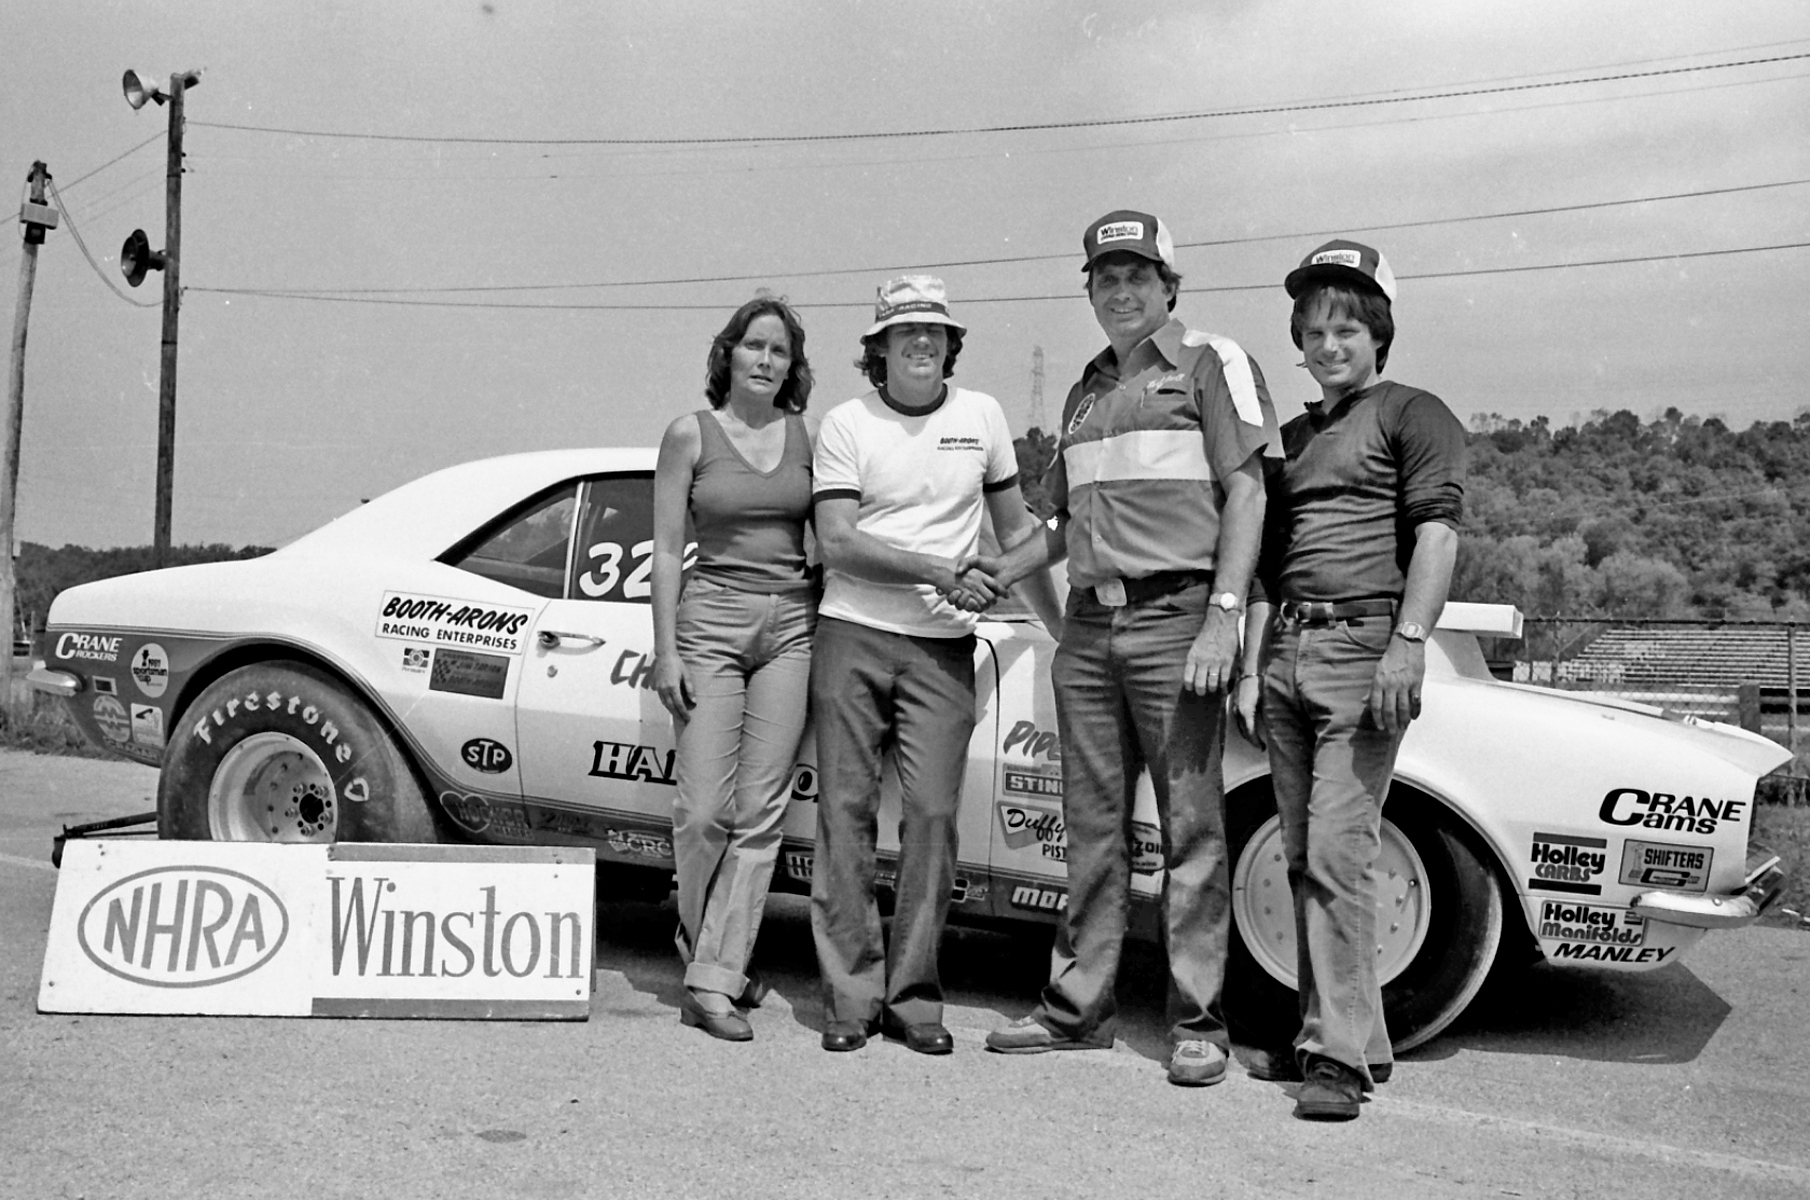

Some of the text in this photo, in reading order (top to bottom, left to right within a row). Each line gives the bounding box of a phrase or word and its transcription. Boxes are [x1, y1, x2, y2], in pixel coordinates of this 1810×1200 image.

[382, 597, 529, 635] BOOTH-ARONS
[55, 633, 123, 659] CRANE
[382, 622, 518, 650] RACING ENTERPRISES
[75, 650, 118, 662] ROCKERS
[193, 691, 352, 763] Firestone
[467, 741, 506, 766] STP
[1010, 775, 1063, 794] STIN
[1599, 788, 1746, 827] CRANE
[627, 837, 672, 856] CRC
[1531, 843, 1606, 874] Holley
[1643, 848, 1704, 870] SHIFTERS
[1535, 864, 1592, 882] CARBS
[103, 879, 267, 973] NHRA
[326, 876, 585, 980] Winston
[1544, 904, 1616, 931] Holley
[1542, 922, 1643, 945] Manifolds
[1554, 943, 1676, 963] MANLEY
